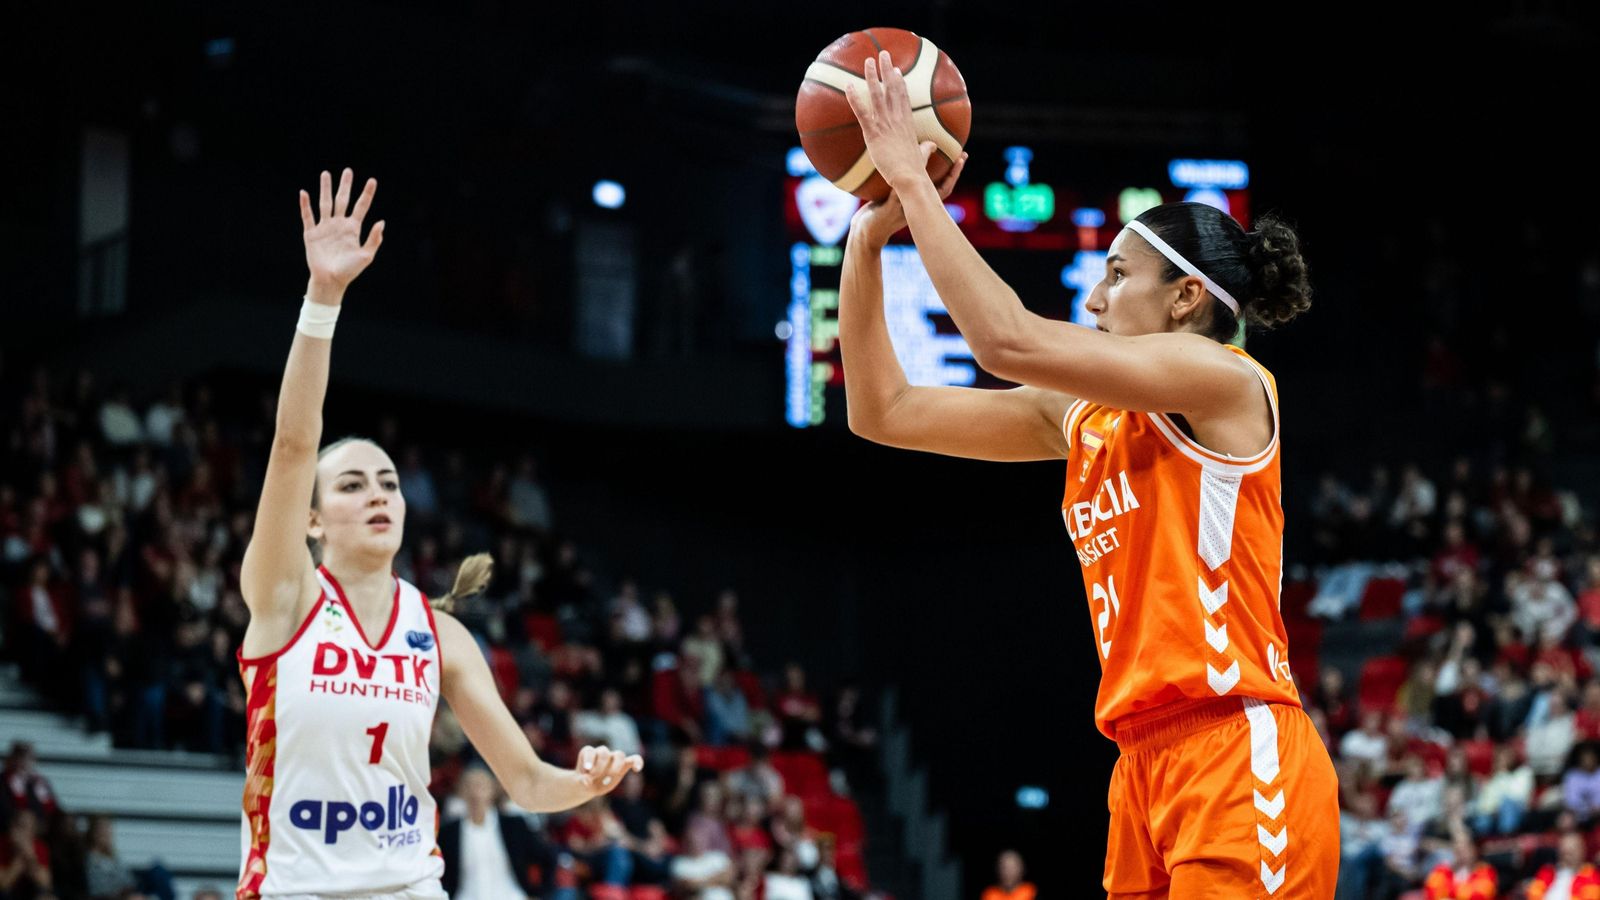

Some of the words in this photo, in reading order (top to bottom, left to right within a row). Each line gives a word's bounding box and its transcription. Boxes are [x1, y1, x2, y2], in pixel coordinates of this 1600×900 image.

[312, 642, 432, 693] DVTK
[366, 722, 389, 764] 1
[289, 784, 418, 844] apollo
